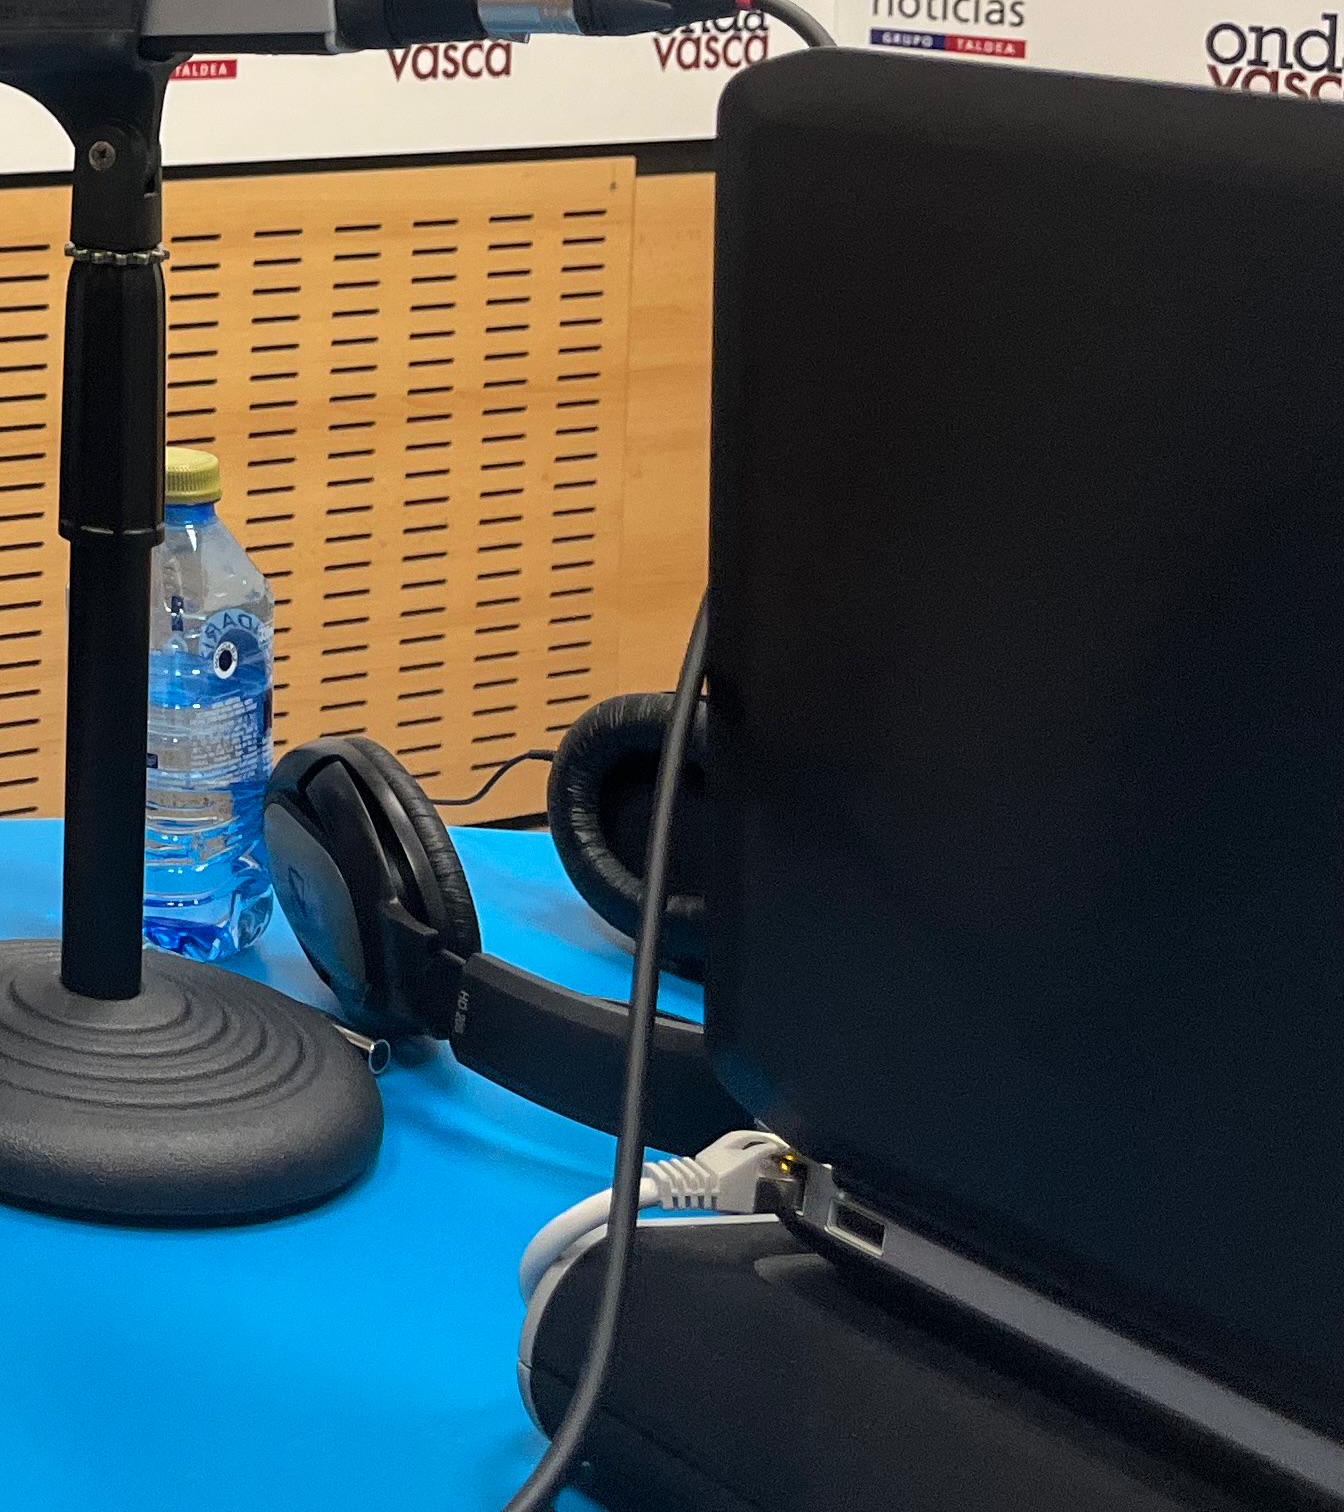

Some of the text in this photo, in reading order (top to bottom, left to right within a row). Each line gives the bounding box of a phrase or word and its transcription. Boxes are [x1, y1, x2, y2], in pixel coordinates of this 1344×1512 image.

[386, 42, 512, 82] vasca
[654, 34, 769, 72] vasca
[882, 31, 1016, 55] GRUPO TALDEA
[1206, 13, 1344, 73] ond
[1207, 65, 1344, 101] vasc
